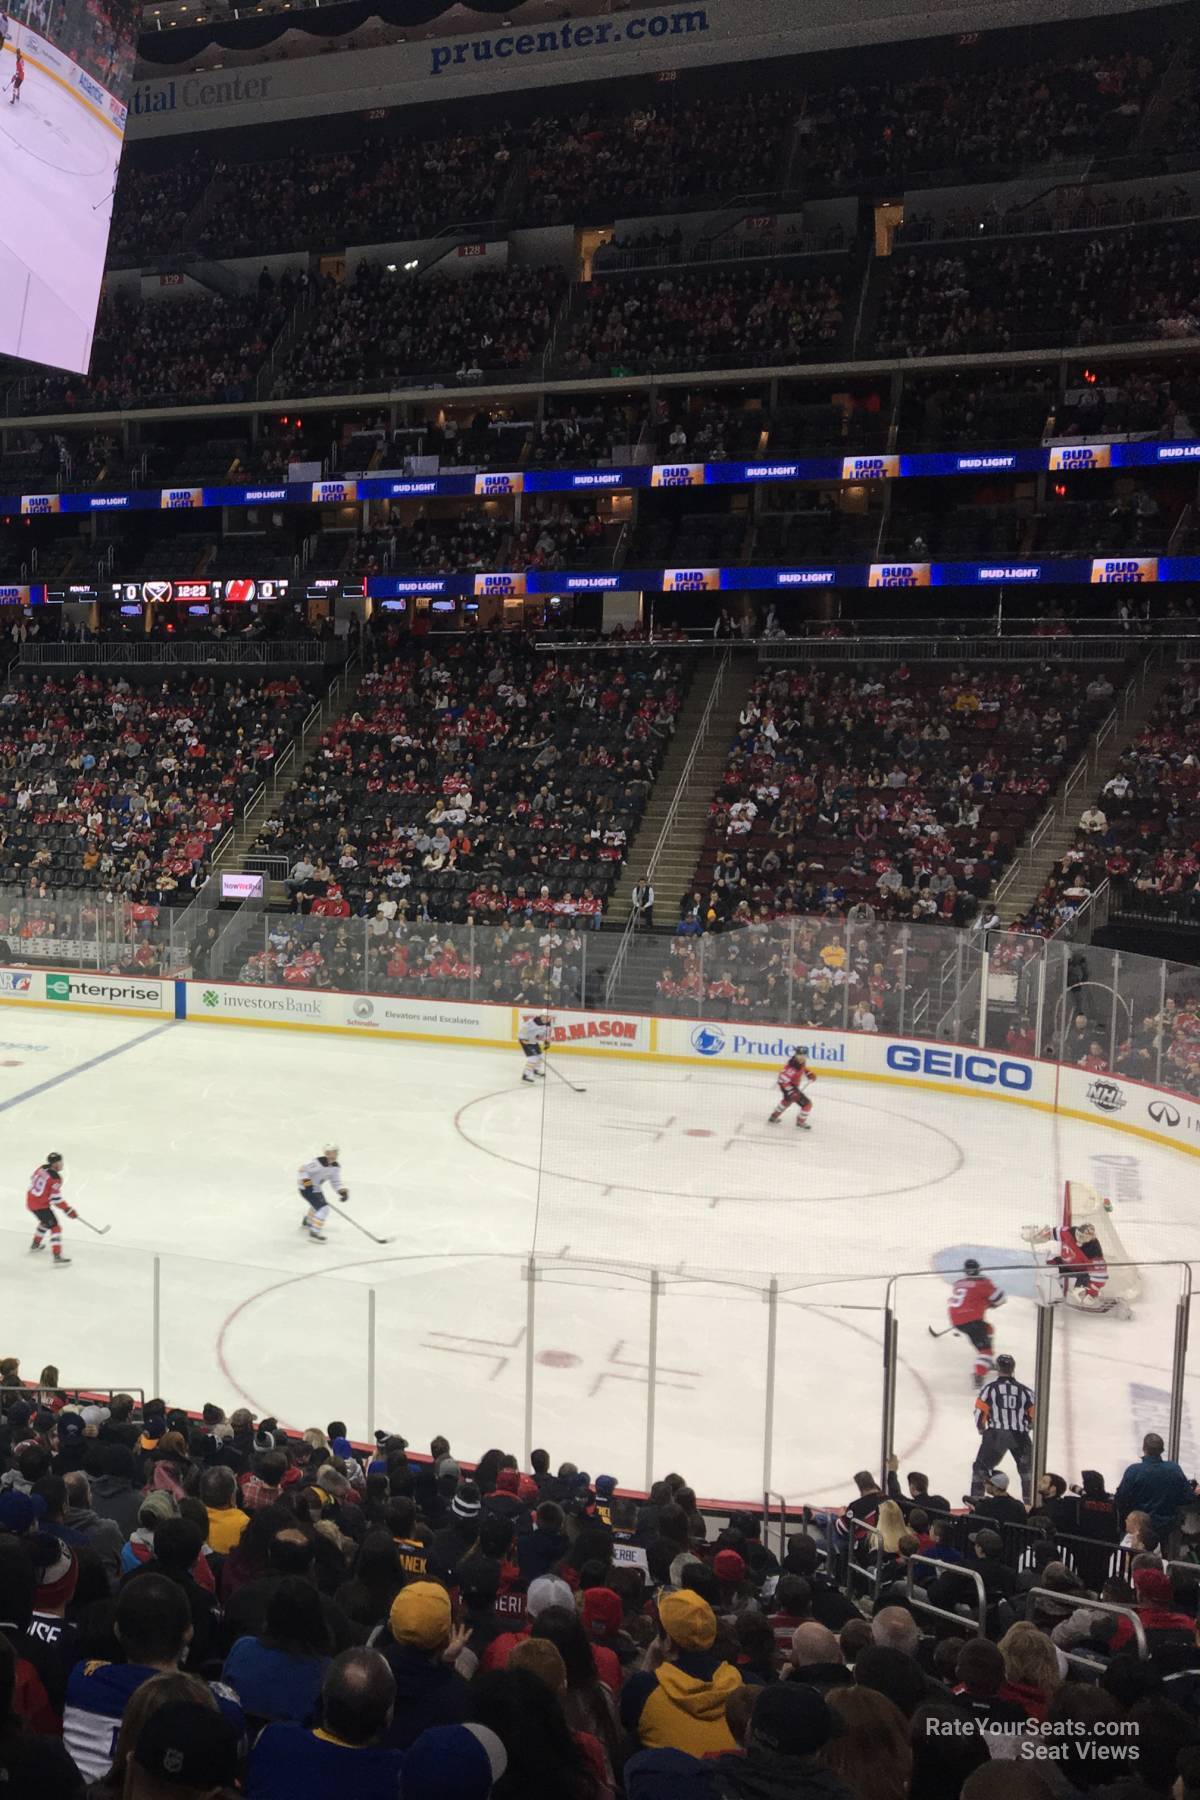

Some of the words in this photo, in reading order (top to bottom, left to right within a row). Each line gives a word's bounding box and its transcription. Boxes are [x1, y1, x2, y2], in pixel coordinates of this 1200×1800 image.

[430, 8, 709, 75] prucenter.com
[182, 74, 272, 108] Center
[1062, 448, 1093, 460] BUD
[855, 458, 884, 470] BUD
[959, 459, 982, 468] BUD
[982, 457, 1014, 467] LIGHT
[662, 467, 689, 477] BUD
[747, 467, 767, 476] BUD
[768, 466, 797, 475] LIGHT
[574, 476, 594, 484] BUD
[594, 475, 621, 483] LIGHT
[393, 484, 410, 493] BUD
[411, 482, 436, 491] LIGHT
[881, 567, 913, 577] BUD
[980, 569, 1005, 578] BUD
[1005, 568, 1039, 578] LIGHT
[1104, 561, 1139, 573] BUD
[568, 578, 589, 587] BUD
[589, 577, 617, 587] LIGHT
[675, 571, 704, 581] BUD
[778, 573, 801, 582] BUD
[801, 573, 833, 582] LIGHT
[126, 585, 137, 600] 0
[178, 585, 207, 597] 12:23
[262, 582, 273, 597] 0
[48, 979, 159, 1001] enterprise
[224, 992, 322, 1014] investorsBank
[385, 1010, 421, 1022] Elevators
[422, 1013, 438, 1023] and
[439, 1014, 480, 1027] Escalators
[887, 1044, 1033, 1092] GEICO
[1087, 1083, 1127, 1107] NHL
[1002, 1395, 1017, 1409] 10
